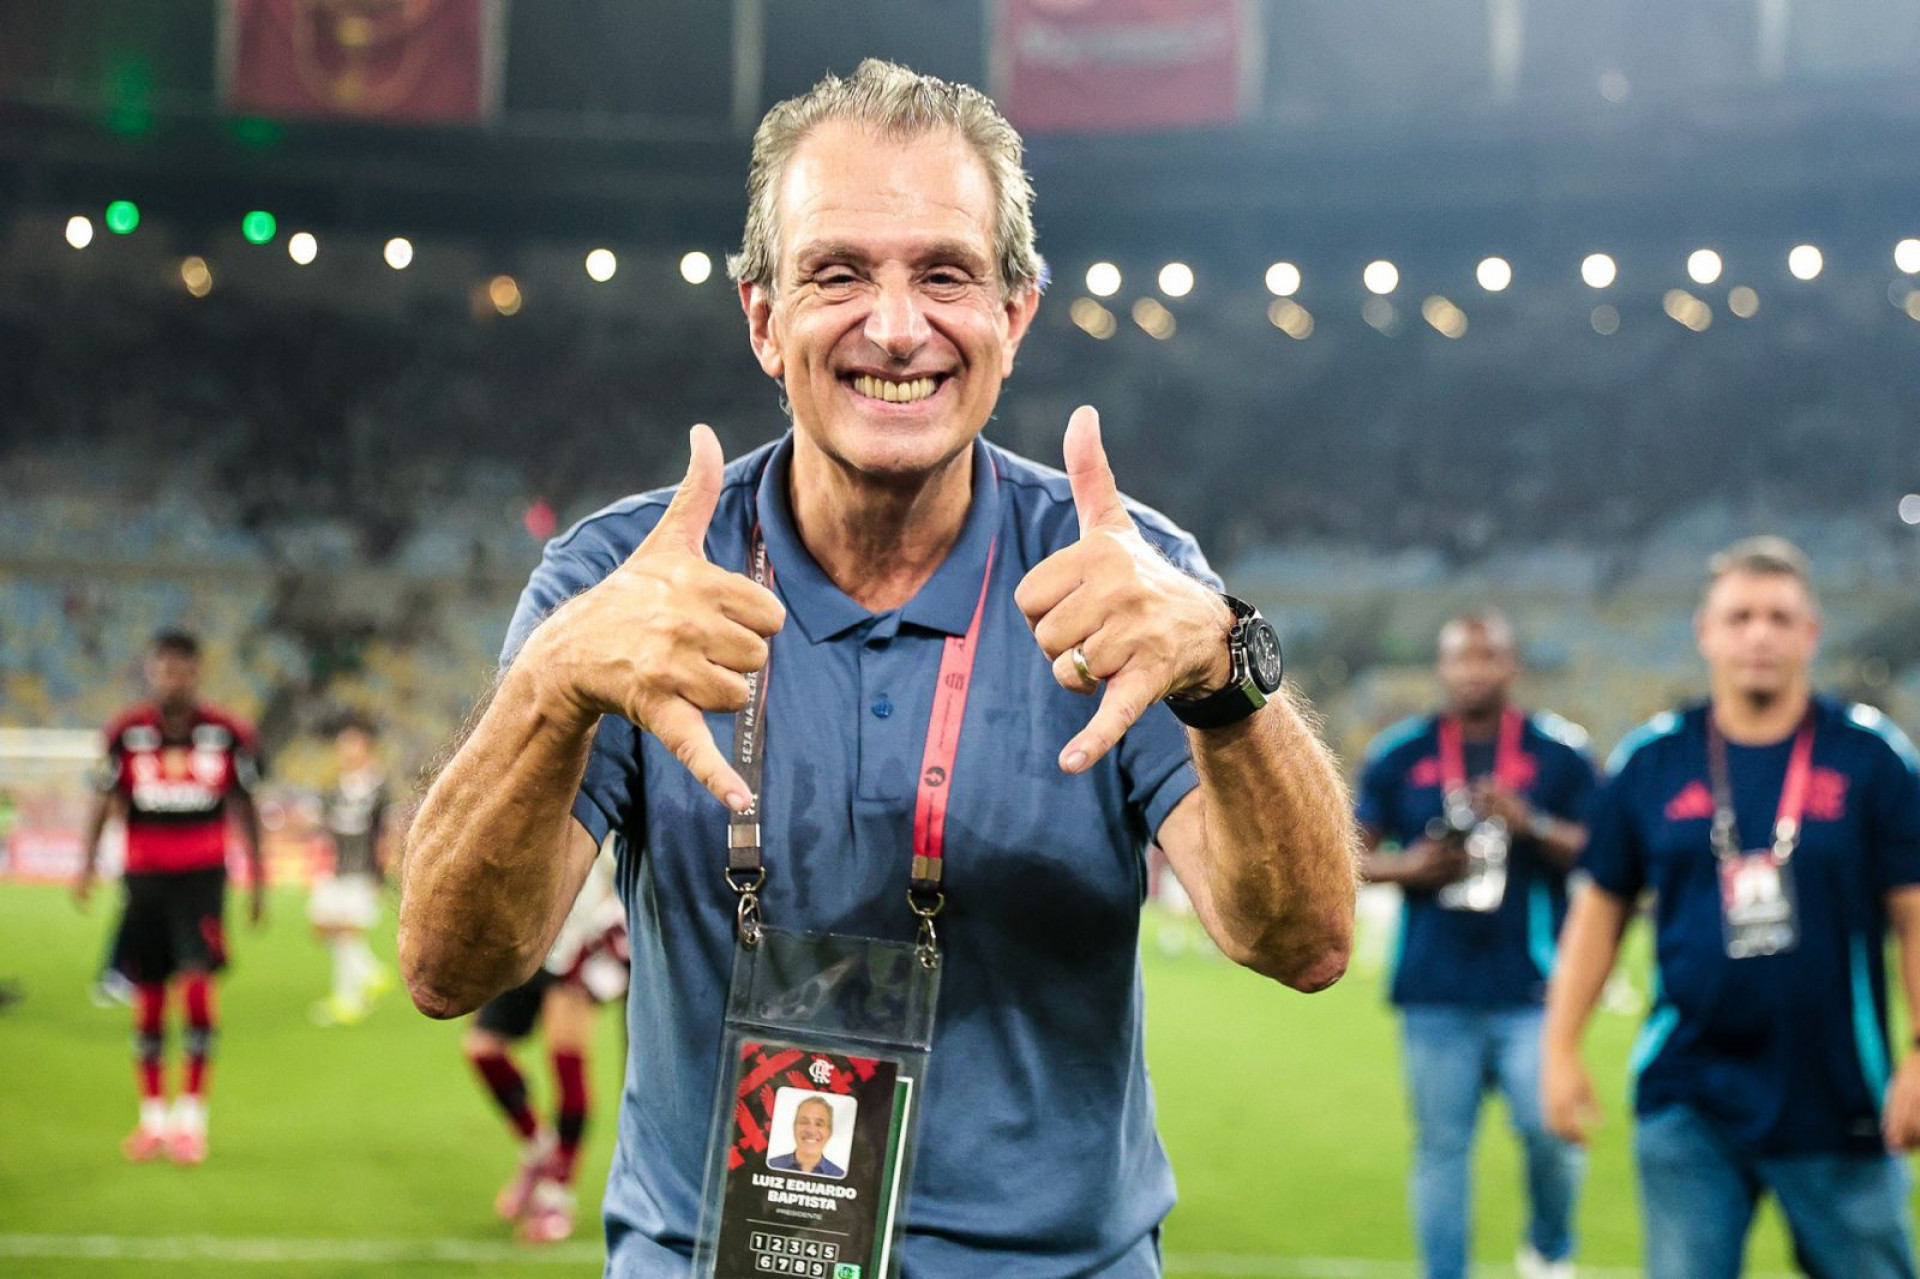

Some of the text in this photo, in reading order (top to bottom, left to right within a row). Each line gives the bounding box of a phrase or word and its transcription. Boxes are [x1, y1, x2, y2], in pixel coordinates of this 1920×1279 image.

[744, 707, 754, 727] NA
[742, 731, 753, 764] SEJA
[751, 1173, 858, 1200] LUIZ EDUARDO
[767, 1189, 838, 1212] BAPTISTA
